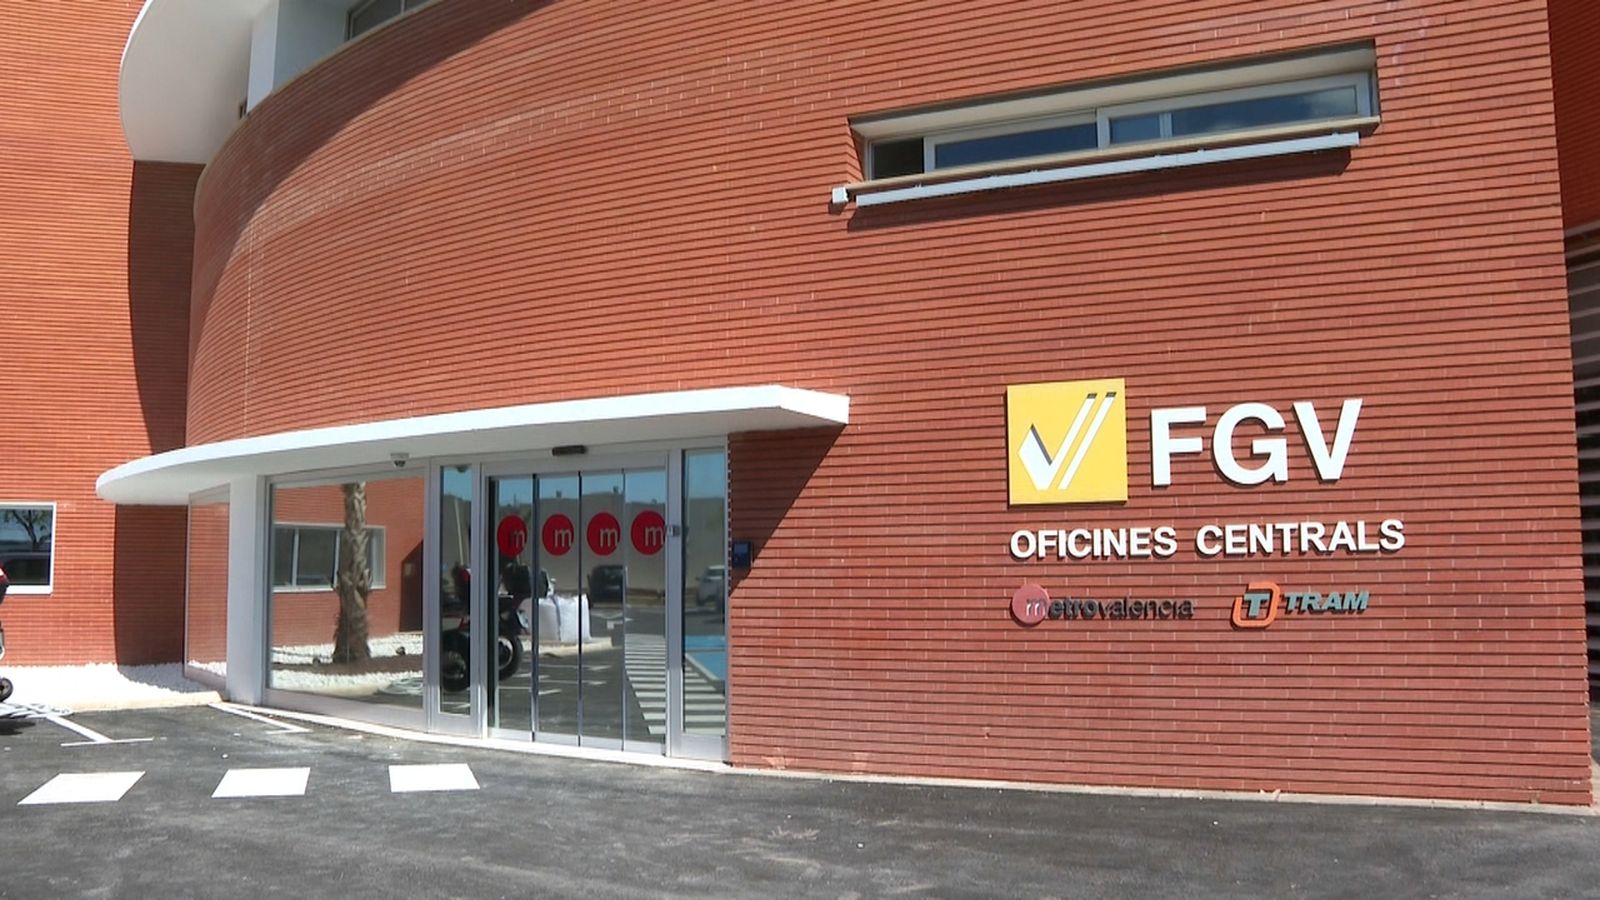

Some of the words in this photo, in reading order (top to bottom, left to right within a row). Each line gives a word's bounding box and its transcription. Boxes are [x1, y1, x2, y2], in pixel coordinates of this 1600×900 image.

[1150, 398, 1364, 488] FGV
[554, 527, 572, 548] m
[600, 527, 619, 548] m
[644, 525, 664, 547] m
[1009, 526, 1178, 560] OFICINES
[1196, 519, 1406, 556] CENTRALS
[1025, 595, 1194, 621] metrovalencia
[1285, 590, 1370, 614] TRAM
